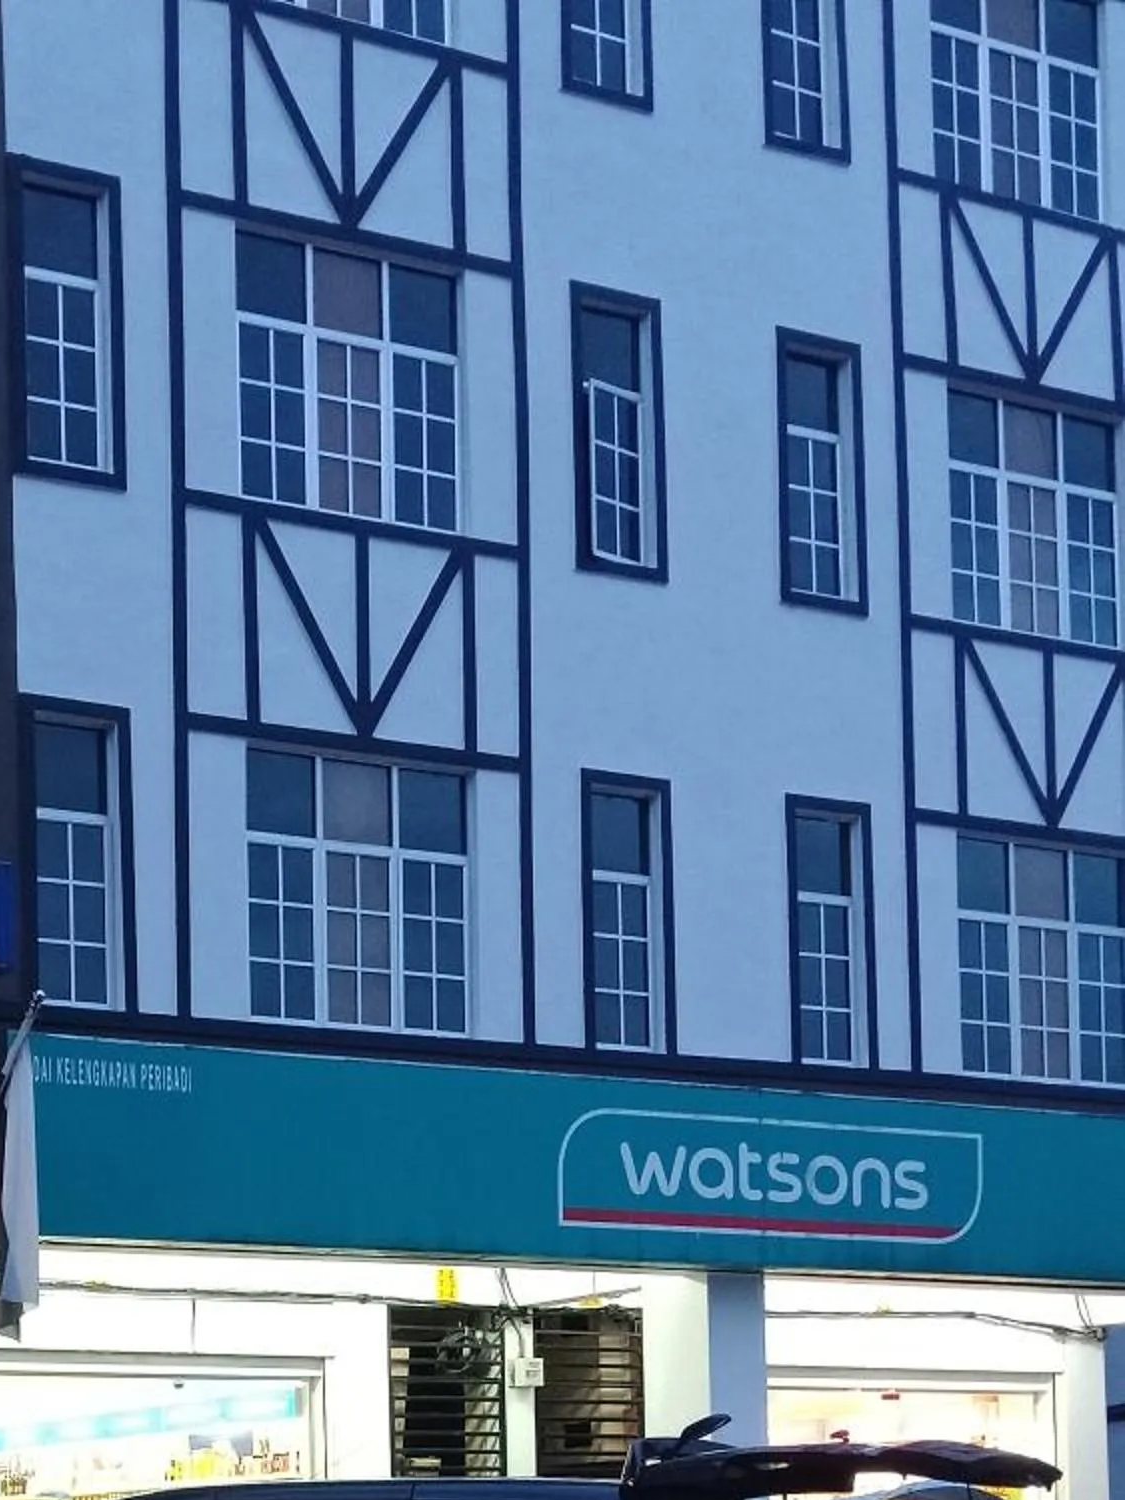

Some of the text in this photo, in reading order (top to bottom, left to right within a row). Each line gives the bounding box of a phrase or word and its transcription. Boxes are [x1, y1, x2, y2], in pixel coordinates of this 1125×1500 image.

[56, 1057, 137, 1090] KELENGKAPAN
[140, 1063, 193, 1093] PERIBADI
[619, 1142, 929, 1211] watsons
